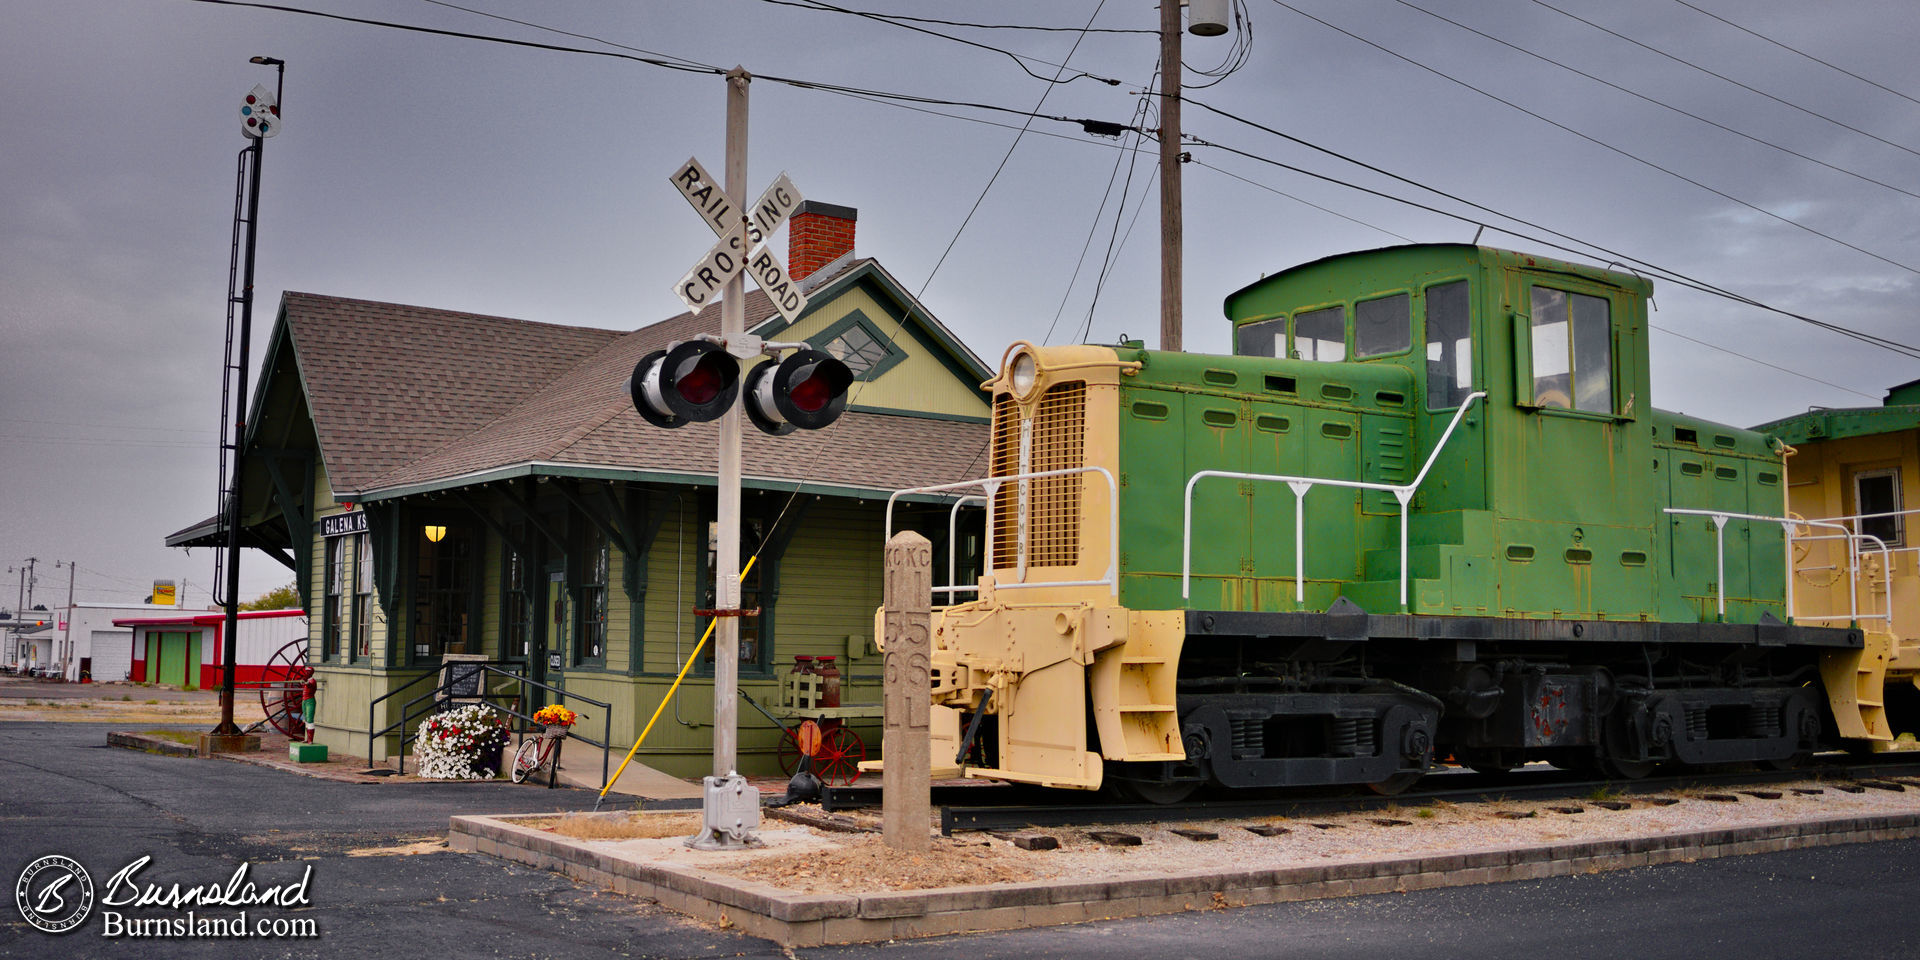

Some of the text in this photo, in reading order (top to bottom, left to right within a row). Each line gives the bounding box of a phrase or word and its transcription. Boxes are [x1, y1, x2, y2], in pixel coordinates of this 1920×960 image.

[678, 165, 799, 312] RAIL ROAD
[1018, 404, 1034, 555] WHITCOMB
[325, 516, 353, 535] GALENA
[907, 548, 930, 567] KC
